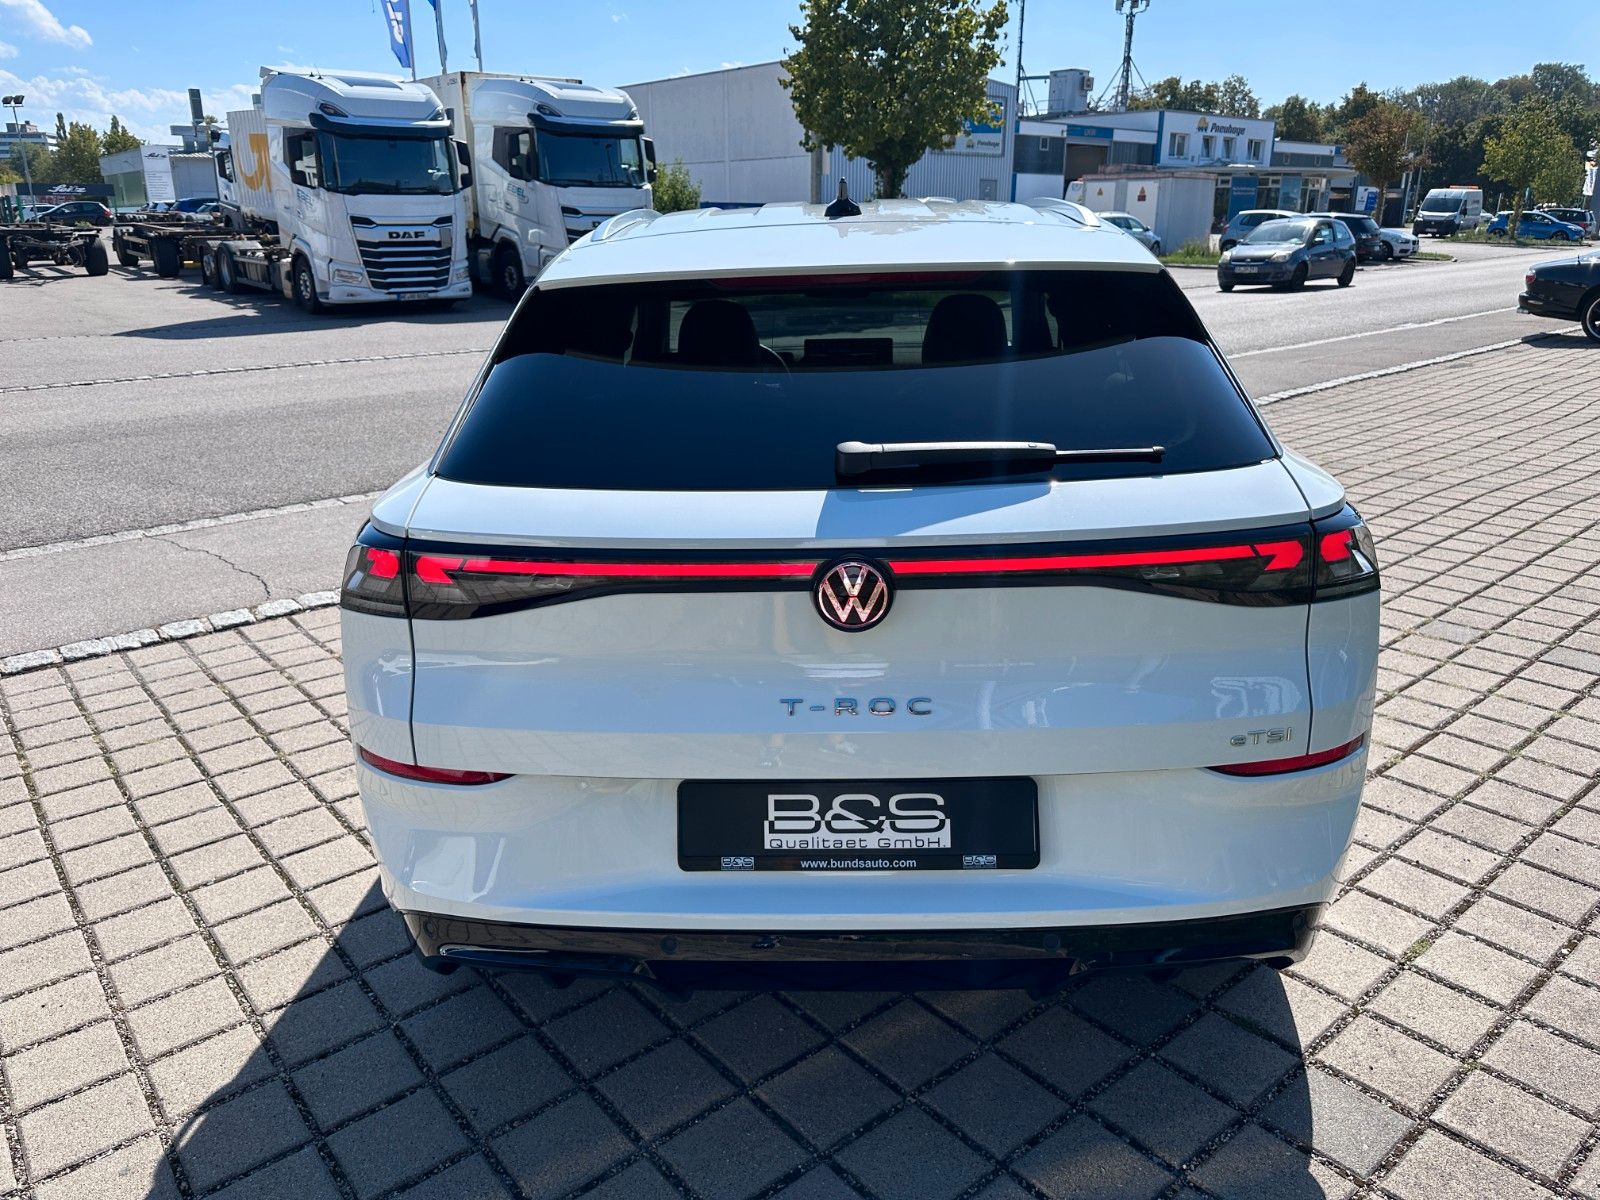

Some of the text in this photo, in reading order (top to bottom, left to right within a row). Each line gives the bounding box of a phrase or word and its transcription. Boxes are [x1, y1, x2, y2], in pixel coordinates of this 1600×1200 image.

[388, 231, 425, 239] DAF
[779, 697, 932, 716] T-ROC
[1230, 727, 1292, 746] eTSI
[767, 793, 946, 834] B&S
[769, 837, 867, 849] Qualitaet
[800, 858, 917, 868] www.bundsauto.com
